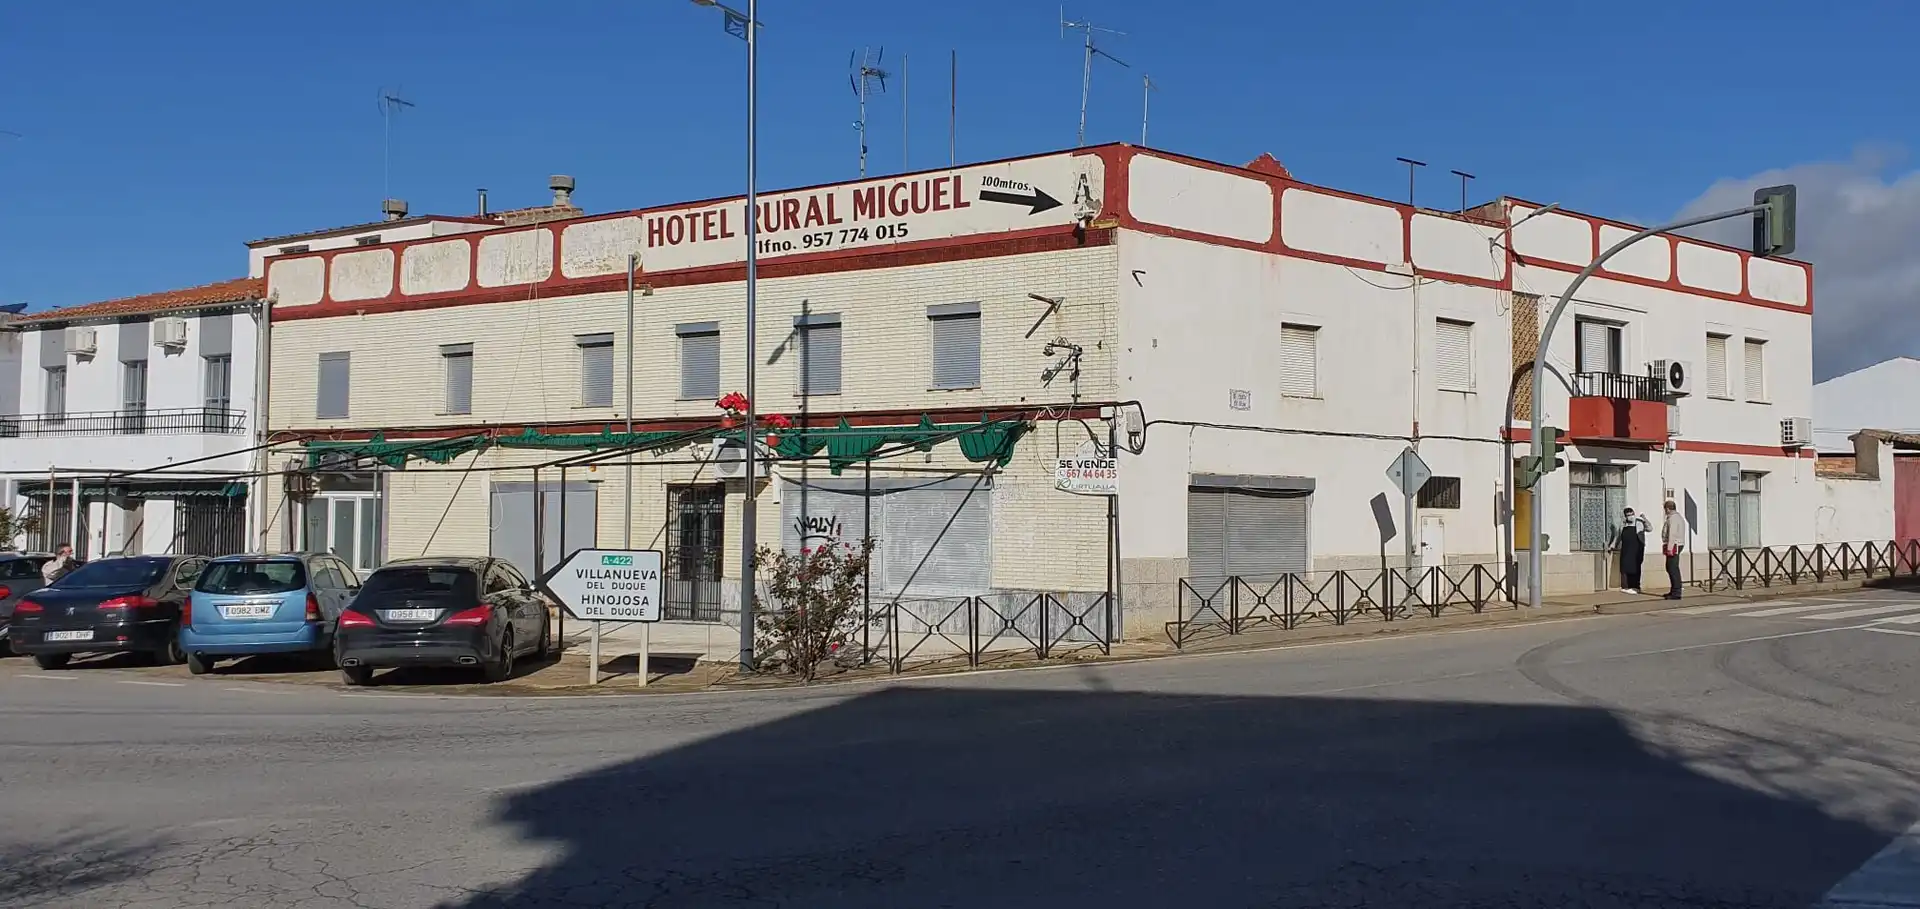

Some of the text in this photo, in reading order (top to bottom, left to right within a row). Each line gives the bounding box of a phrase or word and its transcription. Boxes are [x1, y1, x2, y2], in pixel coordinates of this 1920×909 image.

[980, 175, 1032, 192] 100mtros.
[647, 174, 971, 248] HOTEL RURAL MIGUEL
[754, 222, 909, 254] lfno. 957 774 015
[1059, 459, 1116, 469] SE VENDE
[1066, 469, 1117, 479] 667 44 64 35
[602, 556, 633, 565] A-422
[576, 568, 658, 581] VILLANUEVA
[586, 581, 647, 591] DEL DUQUE
[581, 594, 650, 606] HINOJOSA
[586, 607, 645, 617] DEL DUQUE
